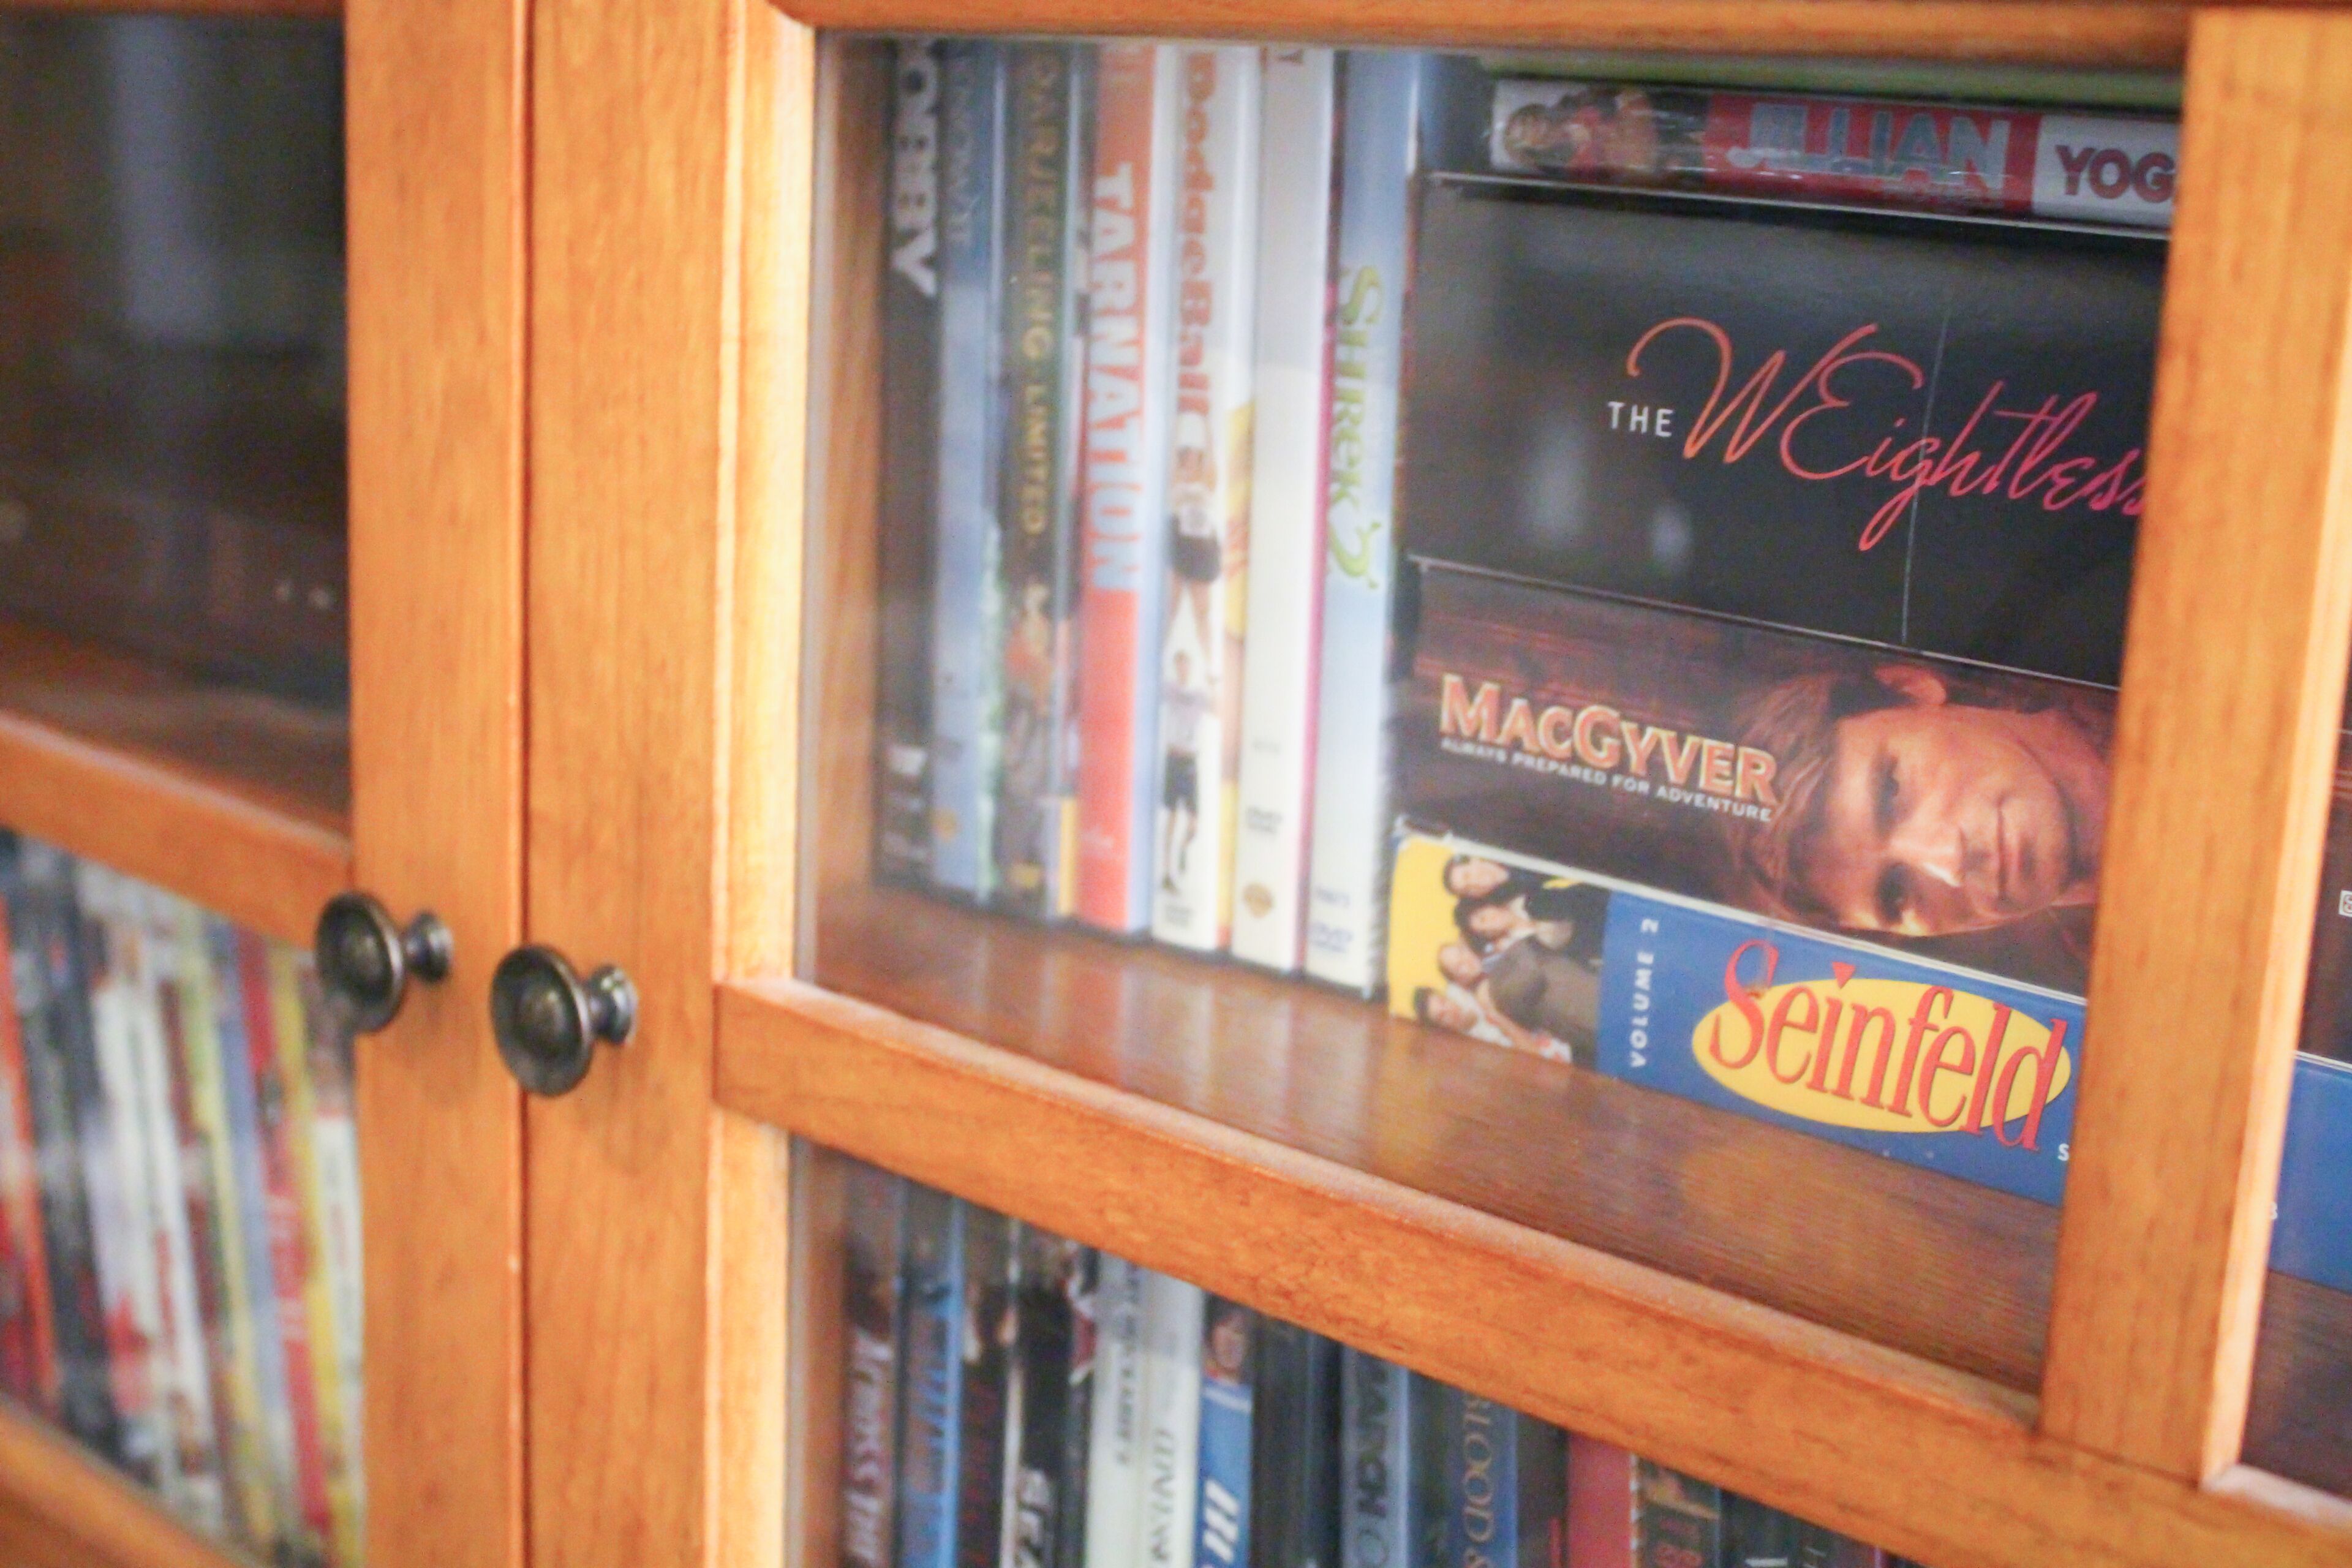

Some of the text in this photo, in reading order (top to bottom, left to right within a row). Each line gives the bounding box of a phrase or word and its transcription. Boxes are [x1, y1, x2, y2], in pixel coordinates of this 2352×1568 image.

[891, 42, 940, 296] OBBY
[1178, 51, 1216, 415] DodgeBall
[1088, 161, 1144, 590] TARNATION
[1608, 400, 1675, 437] THE
[1019, 384, 1048, 535] LIMITED
[1328, 521, 1382, 590] 2
[1440, 736, 1774, 823] ALWAYS PREPARED FOR ADVENTURE
[1628, 917, 1659, 1069] VOLUME 2
[1708, 939, 2068, 1152] Seinfeld
